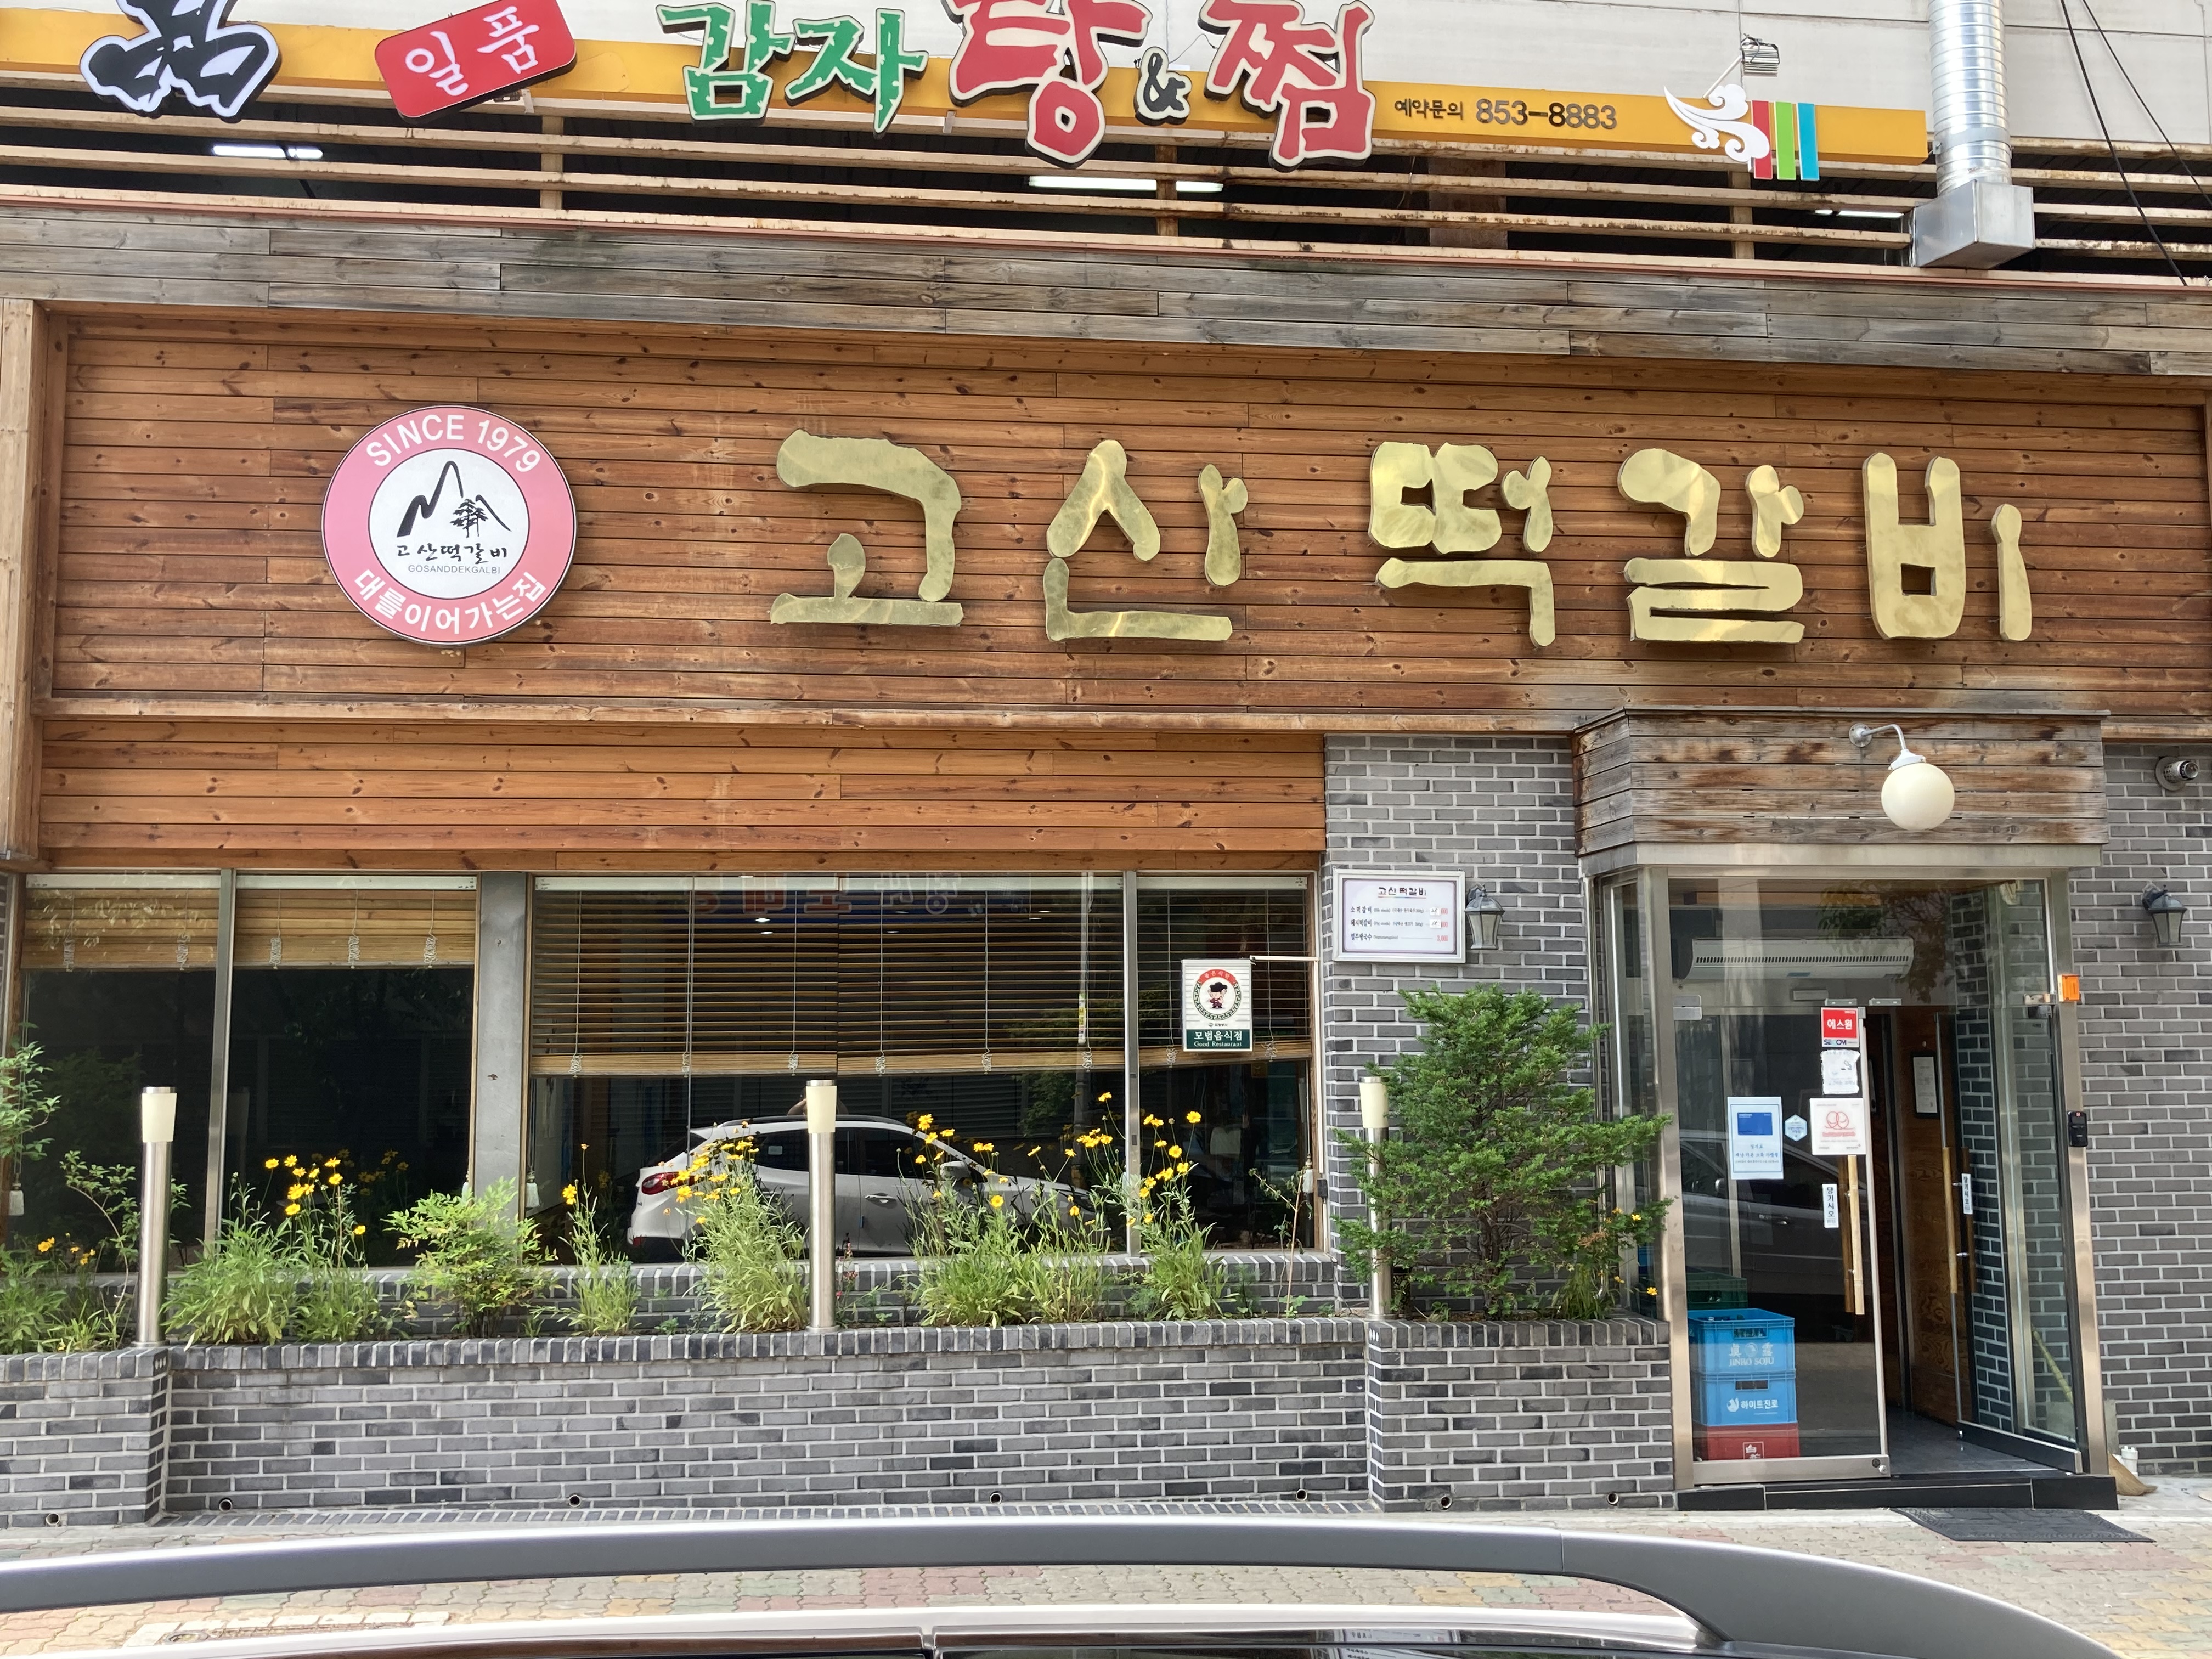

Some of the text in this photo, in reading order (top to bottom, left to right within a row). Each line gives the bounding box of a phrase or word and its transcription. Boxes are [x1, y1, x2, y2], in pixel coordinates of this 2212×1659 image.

[405, 5, 540, 97] 일품
[1394, 98, 1617, 129] 예약문의 853-8883
[366, 414, 541, 473] SINCE 1979
[408, 565, 501, 575] GOSANDDEKGALBI
[1827, 1018, 1853, 1030] 에스원
[1194, 1030, 1243, 1041] 모범음식점
[1826, 1187, 1835, 1217] 당기시오
[1753, 1356, 1775, 1366] SOJU
[1740, 1398, 1779, 1409] 하이트진로
